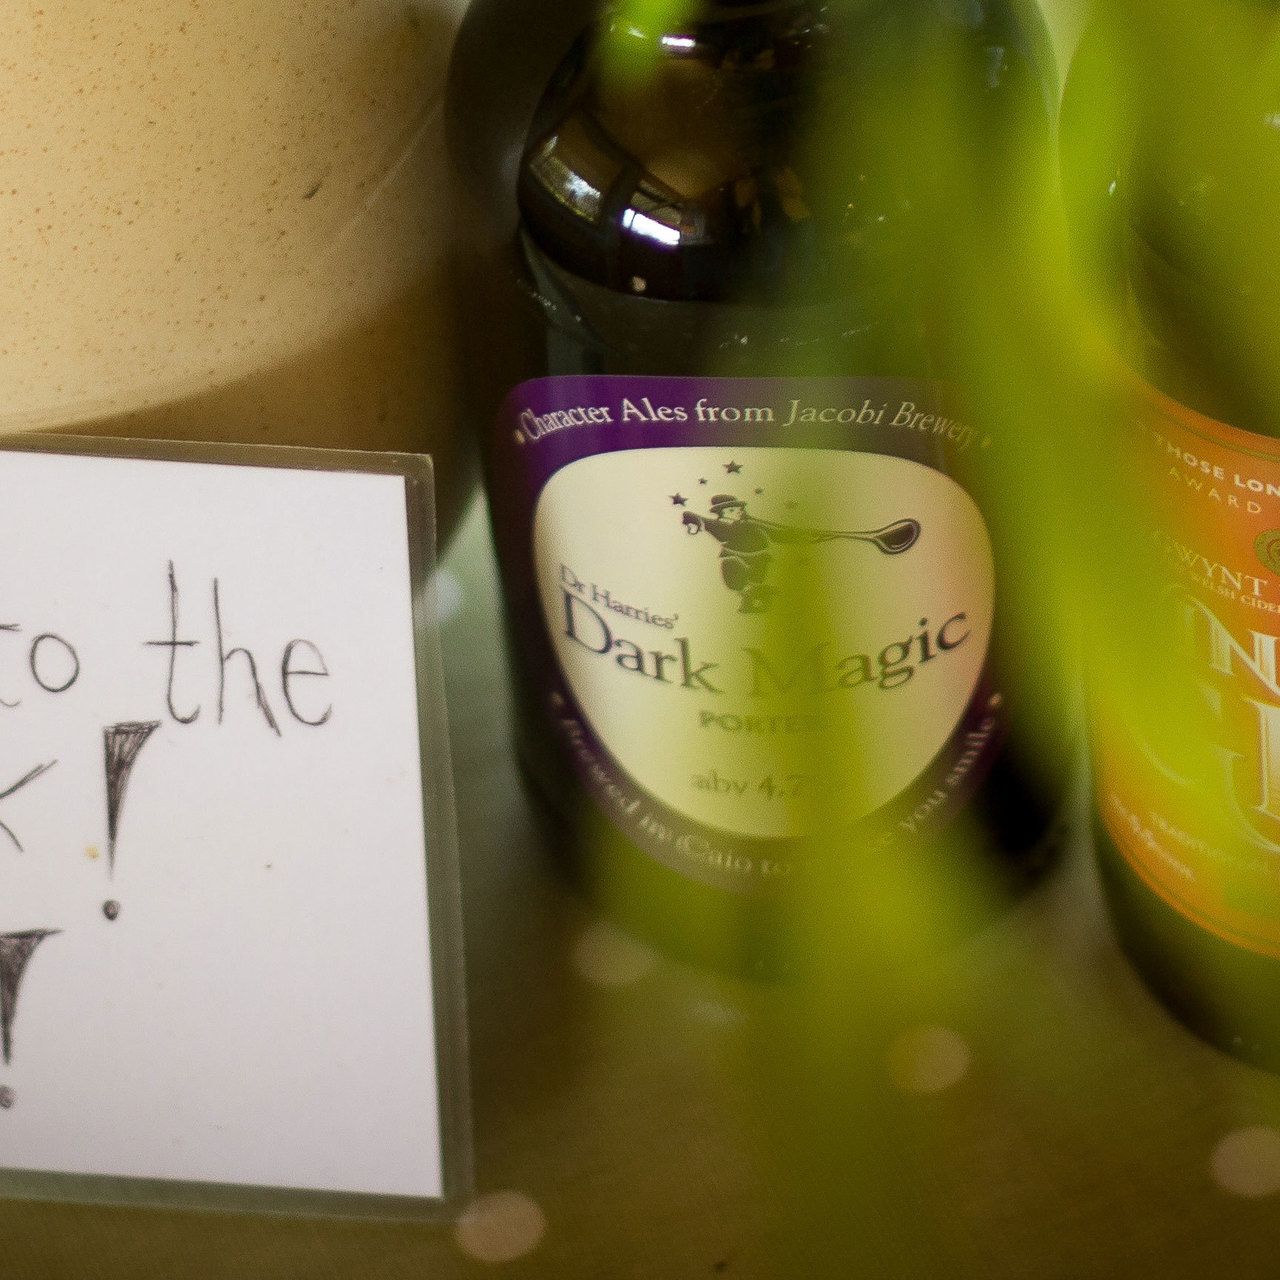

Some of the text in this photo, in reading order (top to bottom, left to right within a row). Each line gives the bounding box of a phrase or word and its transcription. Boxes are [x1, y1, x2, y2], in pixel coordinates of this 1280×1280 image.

[521, 406, 614, 441] Character
[622, 397, 689, 422] Ales
[695, 398, 774, 422] from
[781, 399, 887, 426] Jacobi
[1168, 467, 1262, 514] AWARD
[560, 563, 585, 593] Dr
[141, 559, 336, 737] the
[560, 585, 725, 694] Dark
